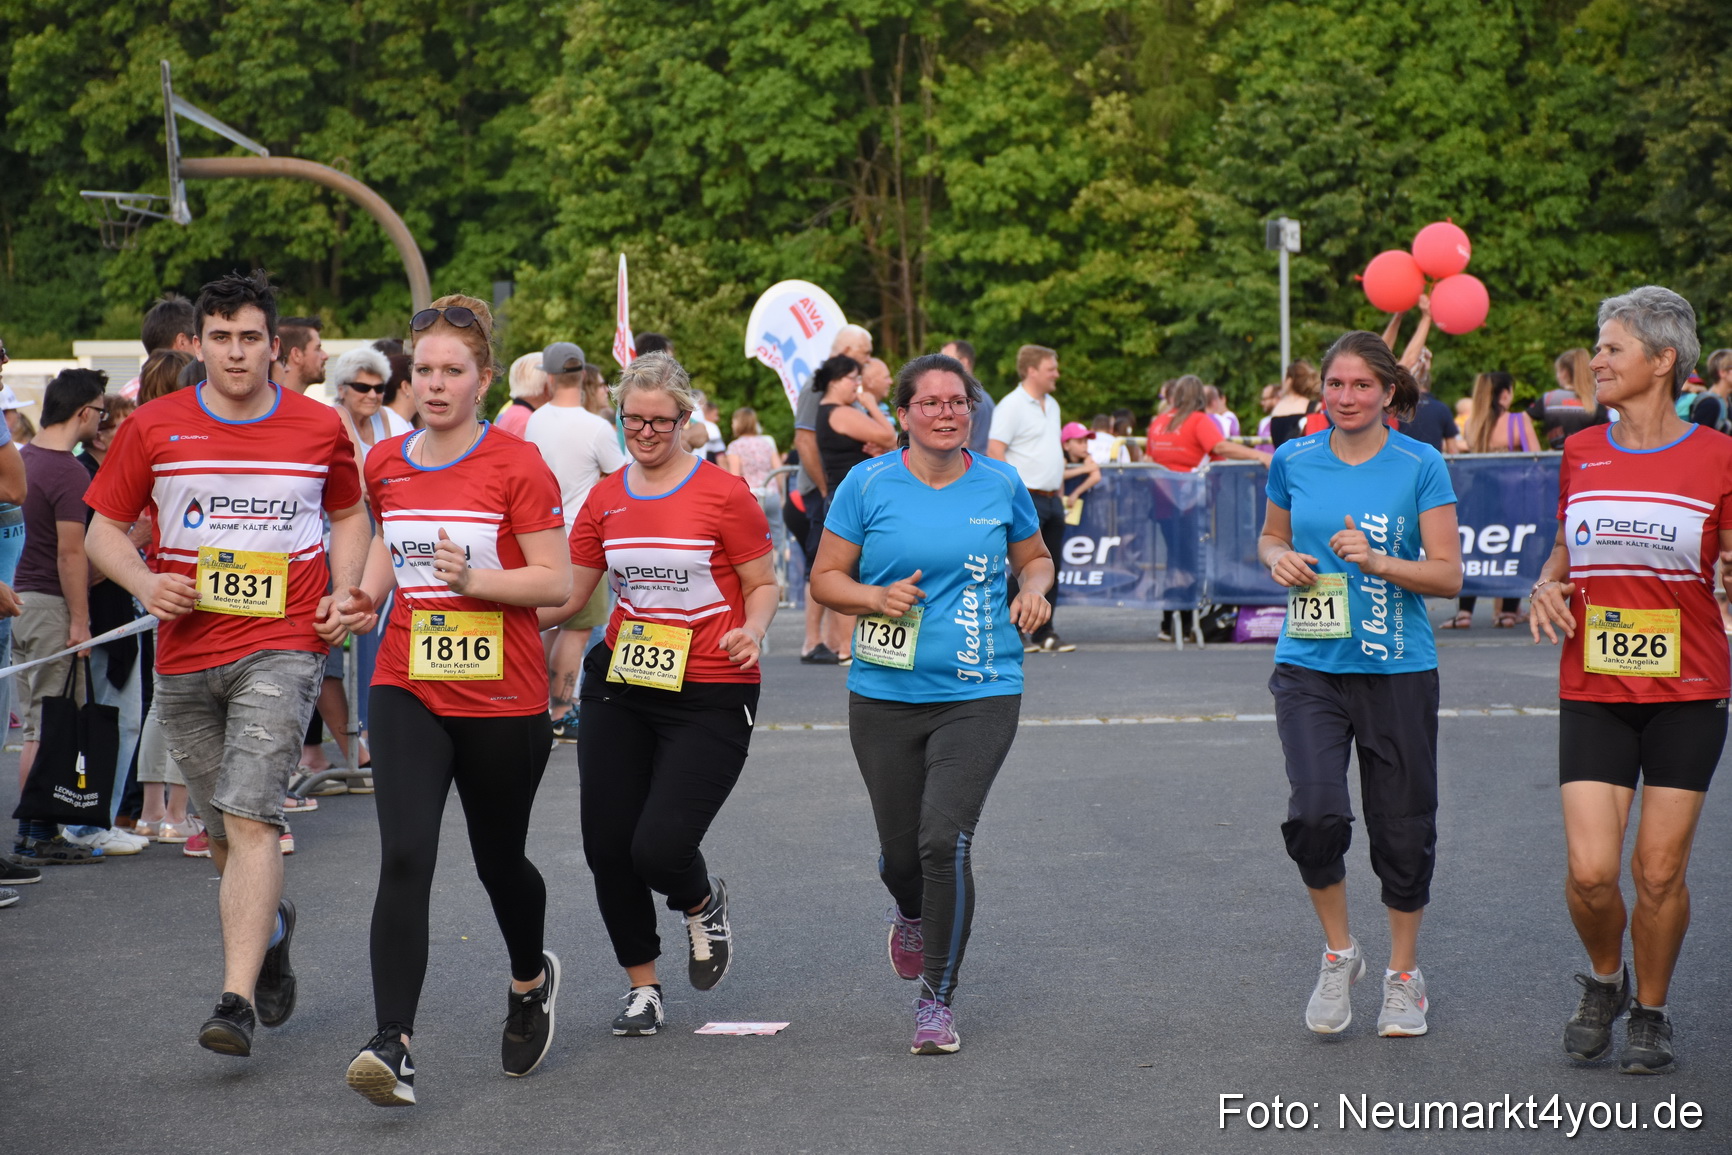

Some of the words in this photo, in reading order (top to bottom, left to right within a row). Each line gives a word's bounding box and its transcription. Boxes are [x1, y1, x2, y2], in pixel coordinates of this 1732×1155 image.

[209, 496, 298, 520] Petry
[209, 523, 240, 531] WÄRME
[243, 523, 269, 531] KÄLTE
[272, 524, 293, 532] KLIMA
[969, 517, 1002, 526] Nathalie
[1360, 512, 1389, 544] di
[1595, 518, 1677, 543] Petry
[1626, 540, 1649, 548] KÄLTE
[1652, 544, 1675, 552] KLIMA
[625, 566, 689, 584] Petry
[963, 553, 989, 582] di
[1461, 560, 1520, 576] BILE
[208, 571, 273, 599] 1831
[213, 595, 241, 604] Mederer
[243, 598, 268, 606] Manuel
[1292, 596, 1335, 620] 1731
[860, 619, 907, 650] 1730
[1393, 602, 1406, 660] Nathalies
[421, 635, 491, 661] 1816
[882, 648, 907, 658] Nathalie
[1596, 631, 1668, 658] 1826
[430, 661, 452, 669] Braun
[453, 661, 480, 669] Kerstin
[621, 643, 676, 672] 1833
[1603, 657, 1625, 665] Janko
[1626, 658, 1660, 667] Angelika
[656, 671, 678, 680] Carina
